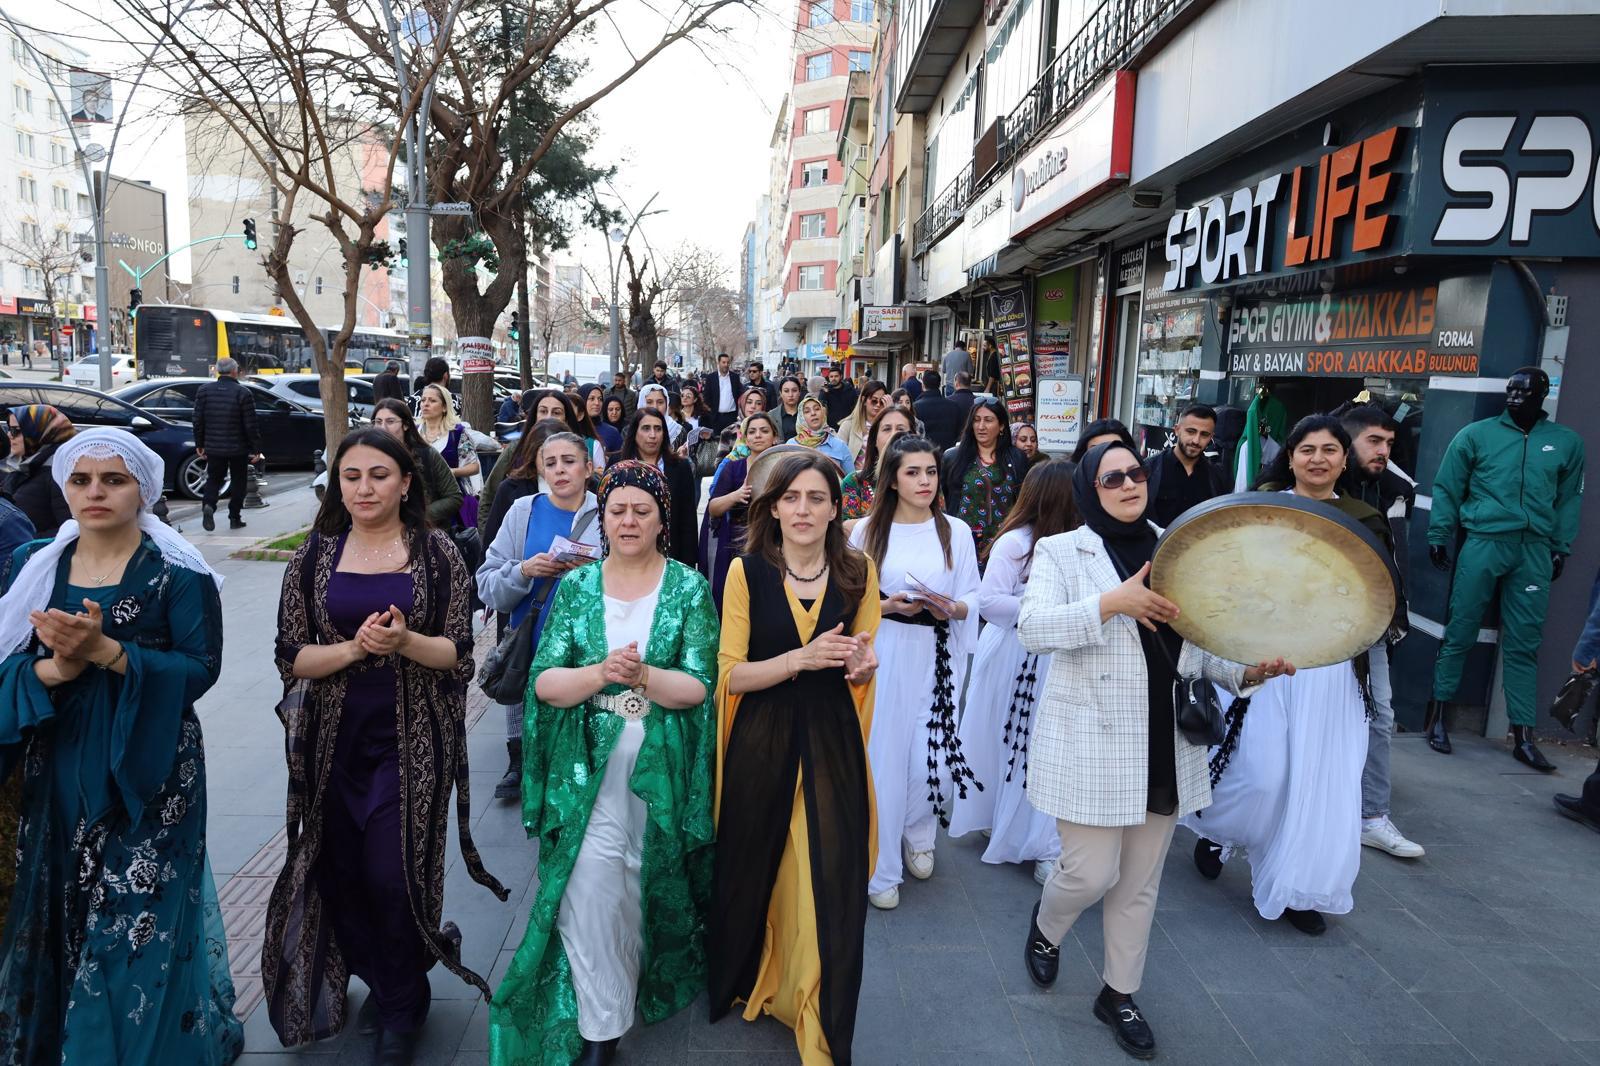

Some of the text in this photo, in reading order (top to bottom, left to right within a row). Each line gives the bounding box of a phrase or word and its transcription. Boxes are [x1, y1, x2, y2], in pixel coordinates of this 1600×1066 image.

[1433, 116, 1600, 241] SP
[1162, 173, 1282, 291] SPORT
[1232, 306, 1269, 343] SPOR
[1315, 293, 1332, 345] &
[1331, 287, 1438, 340] AYAKKAB
[1438, 330, 1475, 347] FORMA
[1232, 349, 1427, 373] BAY & BAYAN SPOR AYAKKAB
[1429, 355, 1478, 371] BULUNUR
